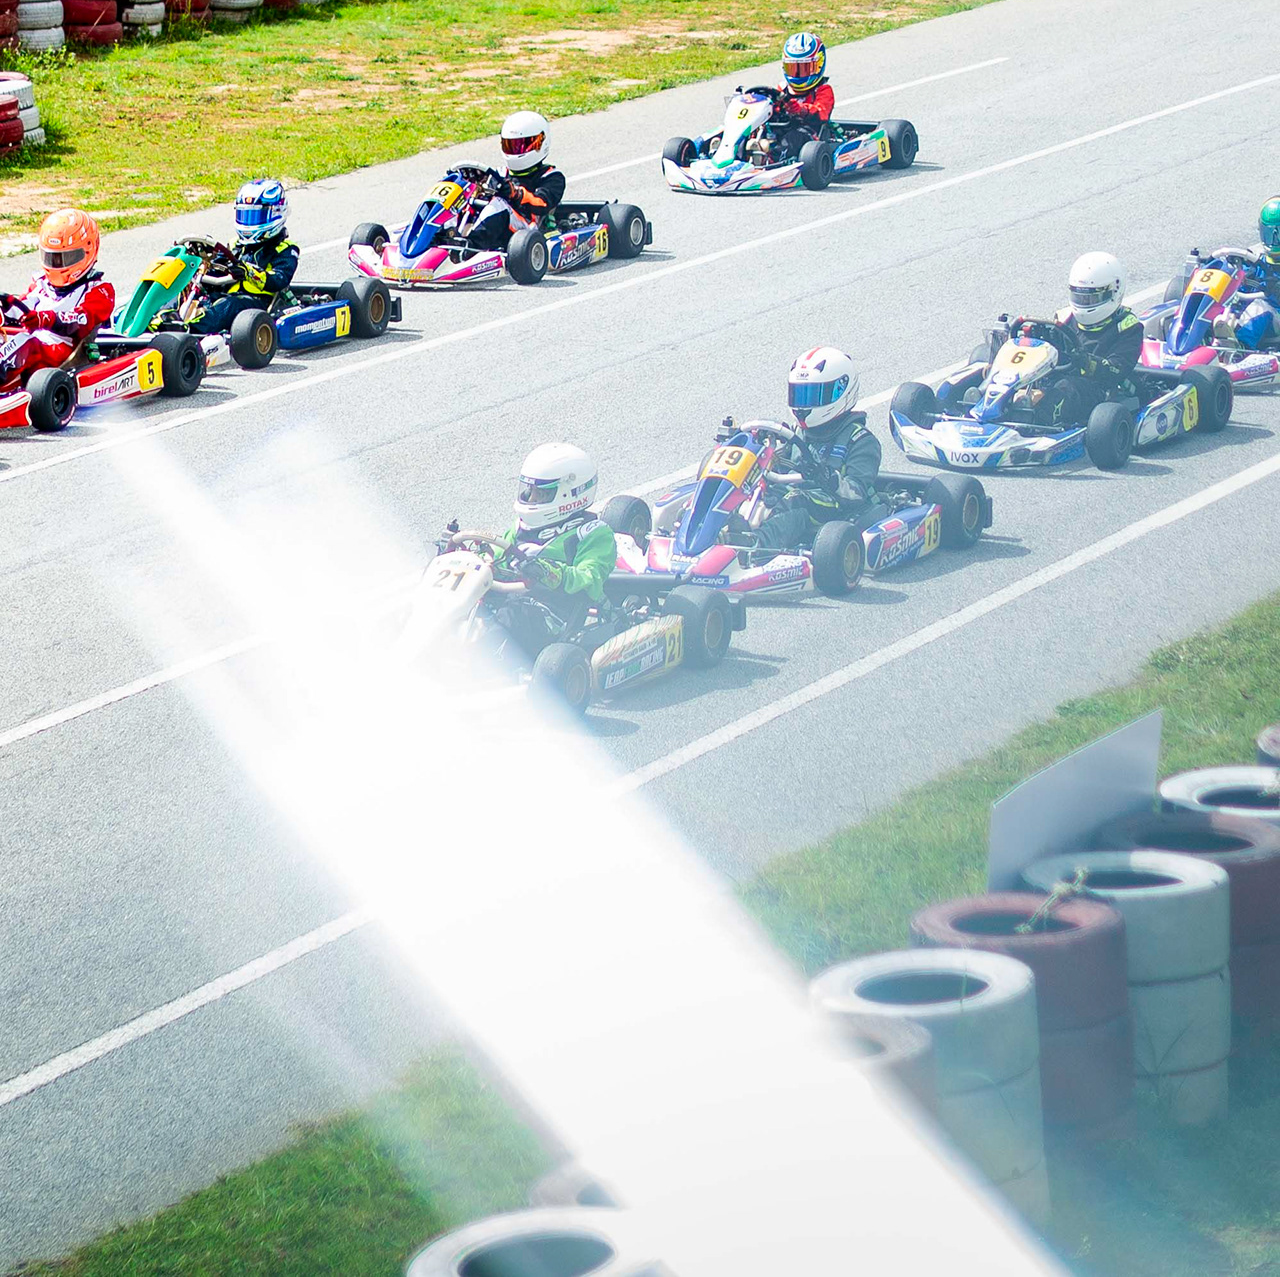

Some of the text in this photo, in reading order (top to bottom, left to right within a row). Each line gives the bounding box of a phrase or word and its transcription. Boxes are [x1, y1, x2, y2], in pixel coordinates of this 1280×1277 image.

[738, 108, 749, 119] 9
[881, 140, 887, 158] 9
[431, 185, 453, 197] 16
[597, 231, 607, 253] 16
[153, 262, 166, 272] 7
[1200, 271, 1214, 283] 8
[340, 310, 347, 332] 7
[1011, 351, 1026, 364] 6
[147, 361, 155, 385] 5
[1187, 397, 1194, 421] 6
[715, 449, 744, 466] 19
[558, 496, 589, 513] ROTAX
[927, 517, 939, 547] 19
[880, 525, 920, 567] KOSMIC
[432, 569, 466, 592] 21
[768, 567, 804, 582] KOSMIC
[668, 629, 681, 663] 21
